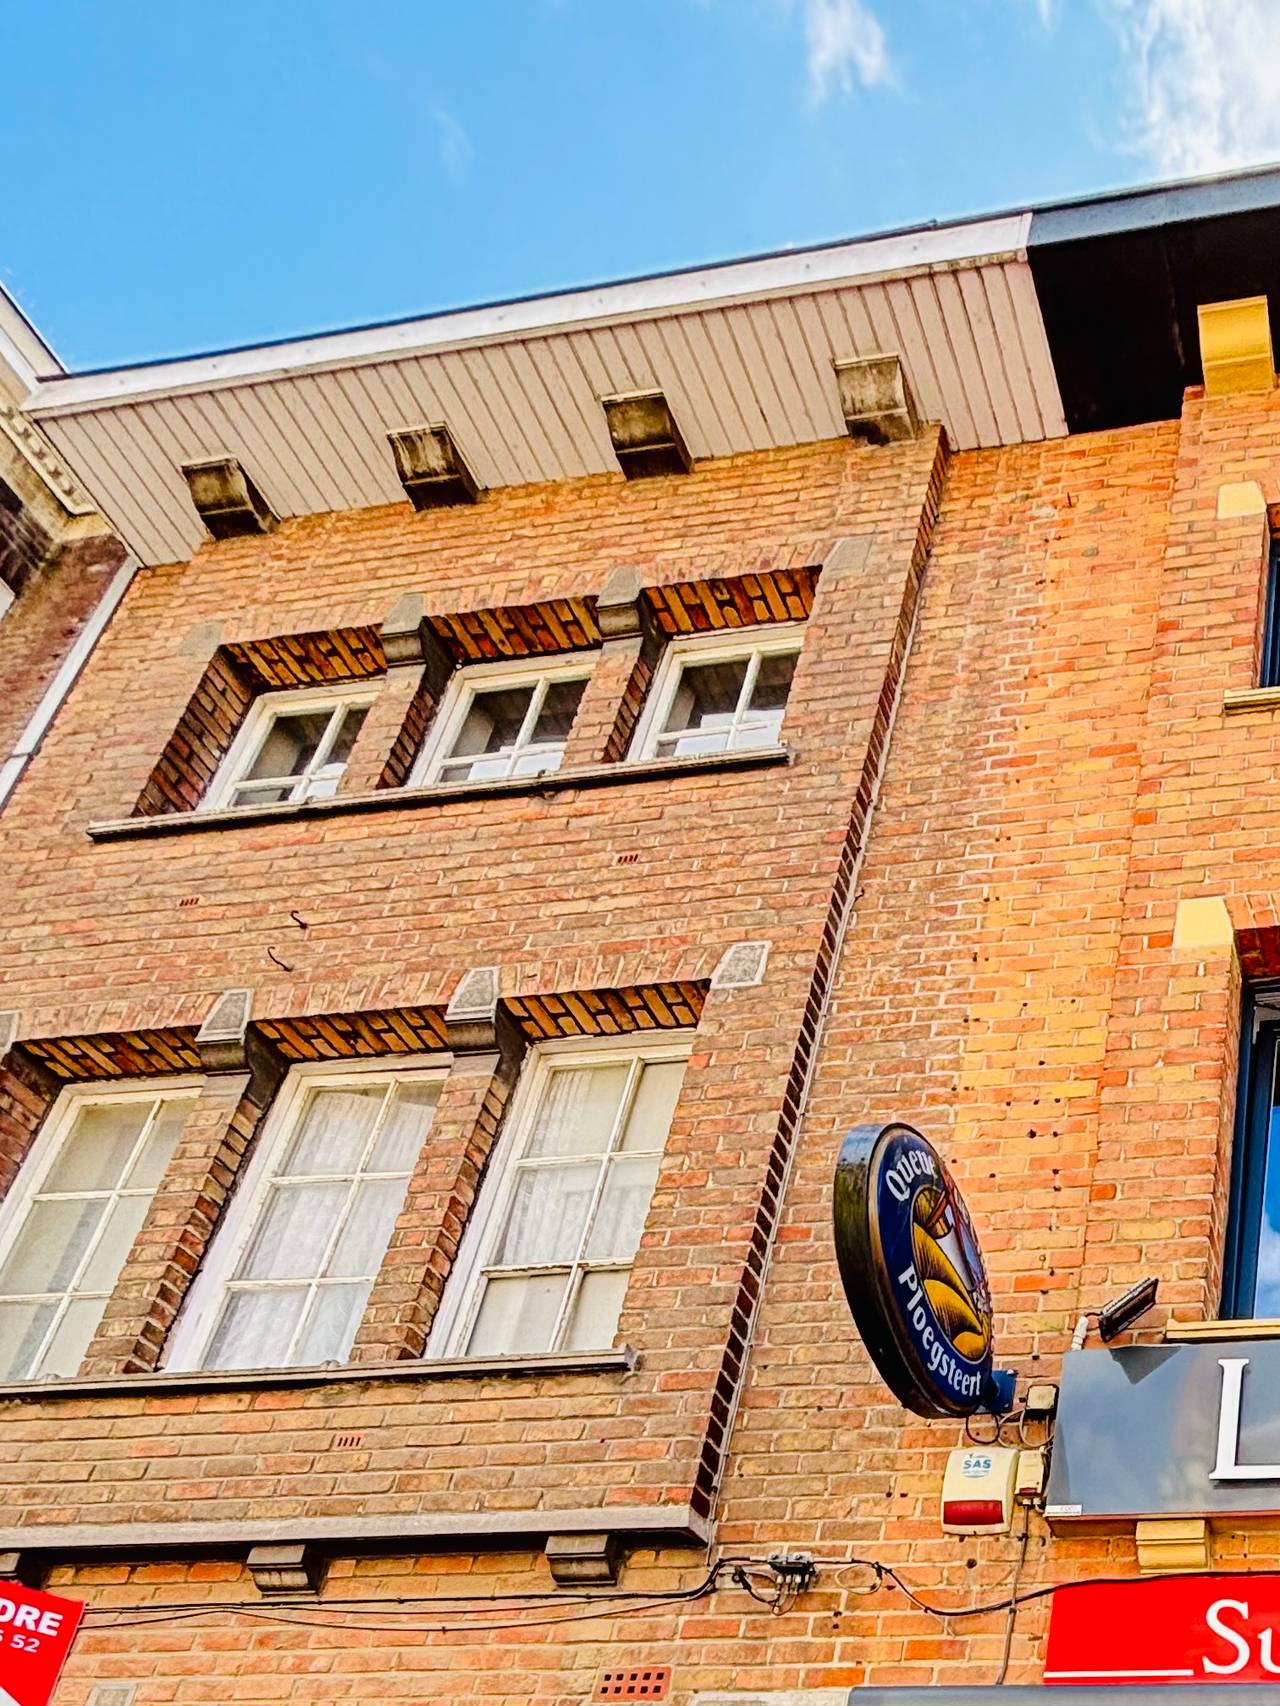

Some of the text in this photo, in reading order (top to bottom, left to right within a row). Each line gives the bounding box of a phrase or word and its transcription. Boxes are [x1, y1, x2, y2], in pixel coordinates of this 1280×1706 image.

[898, 1261, 981, 1397] Ploegsteert
[963, 1459, 991, 1470] SAS
[10, 1633, 40, 1653] 52
